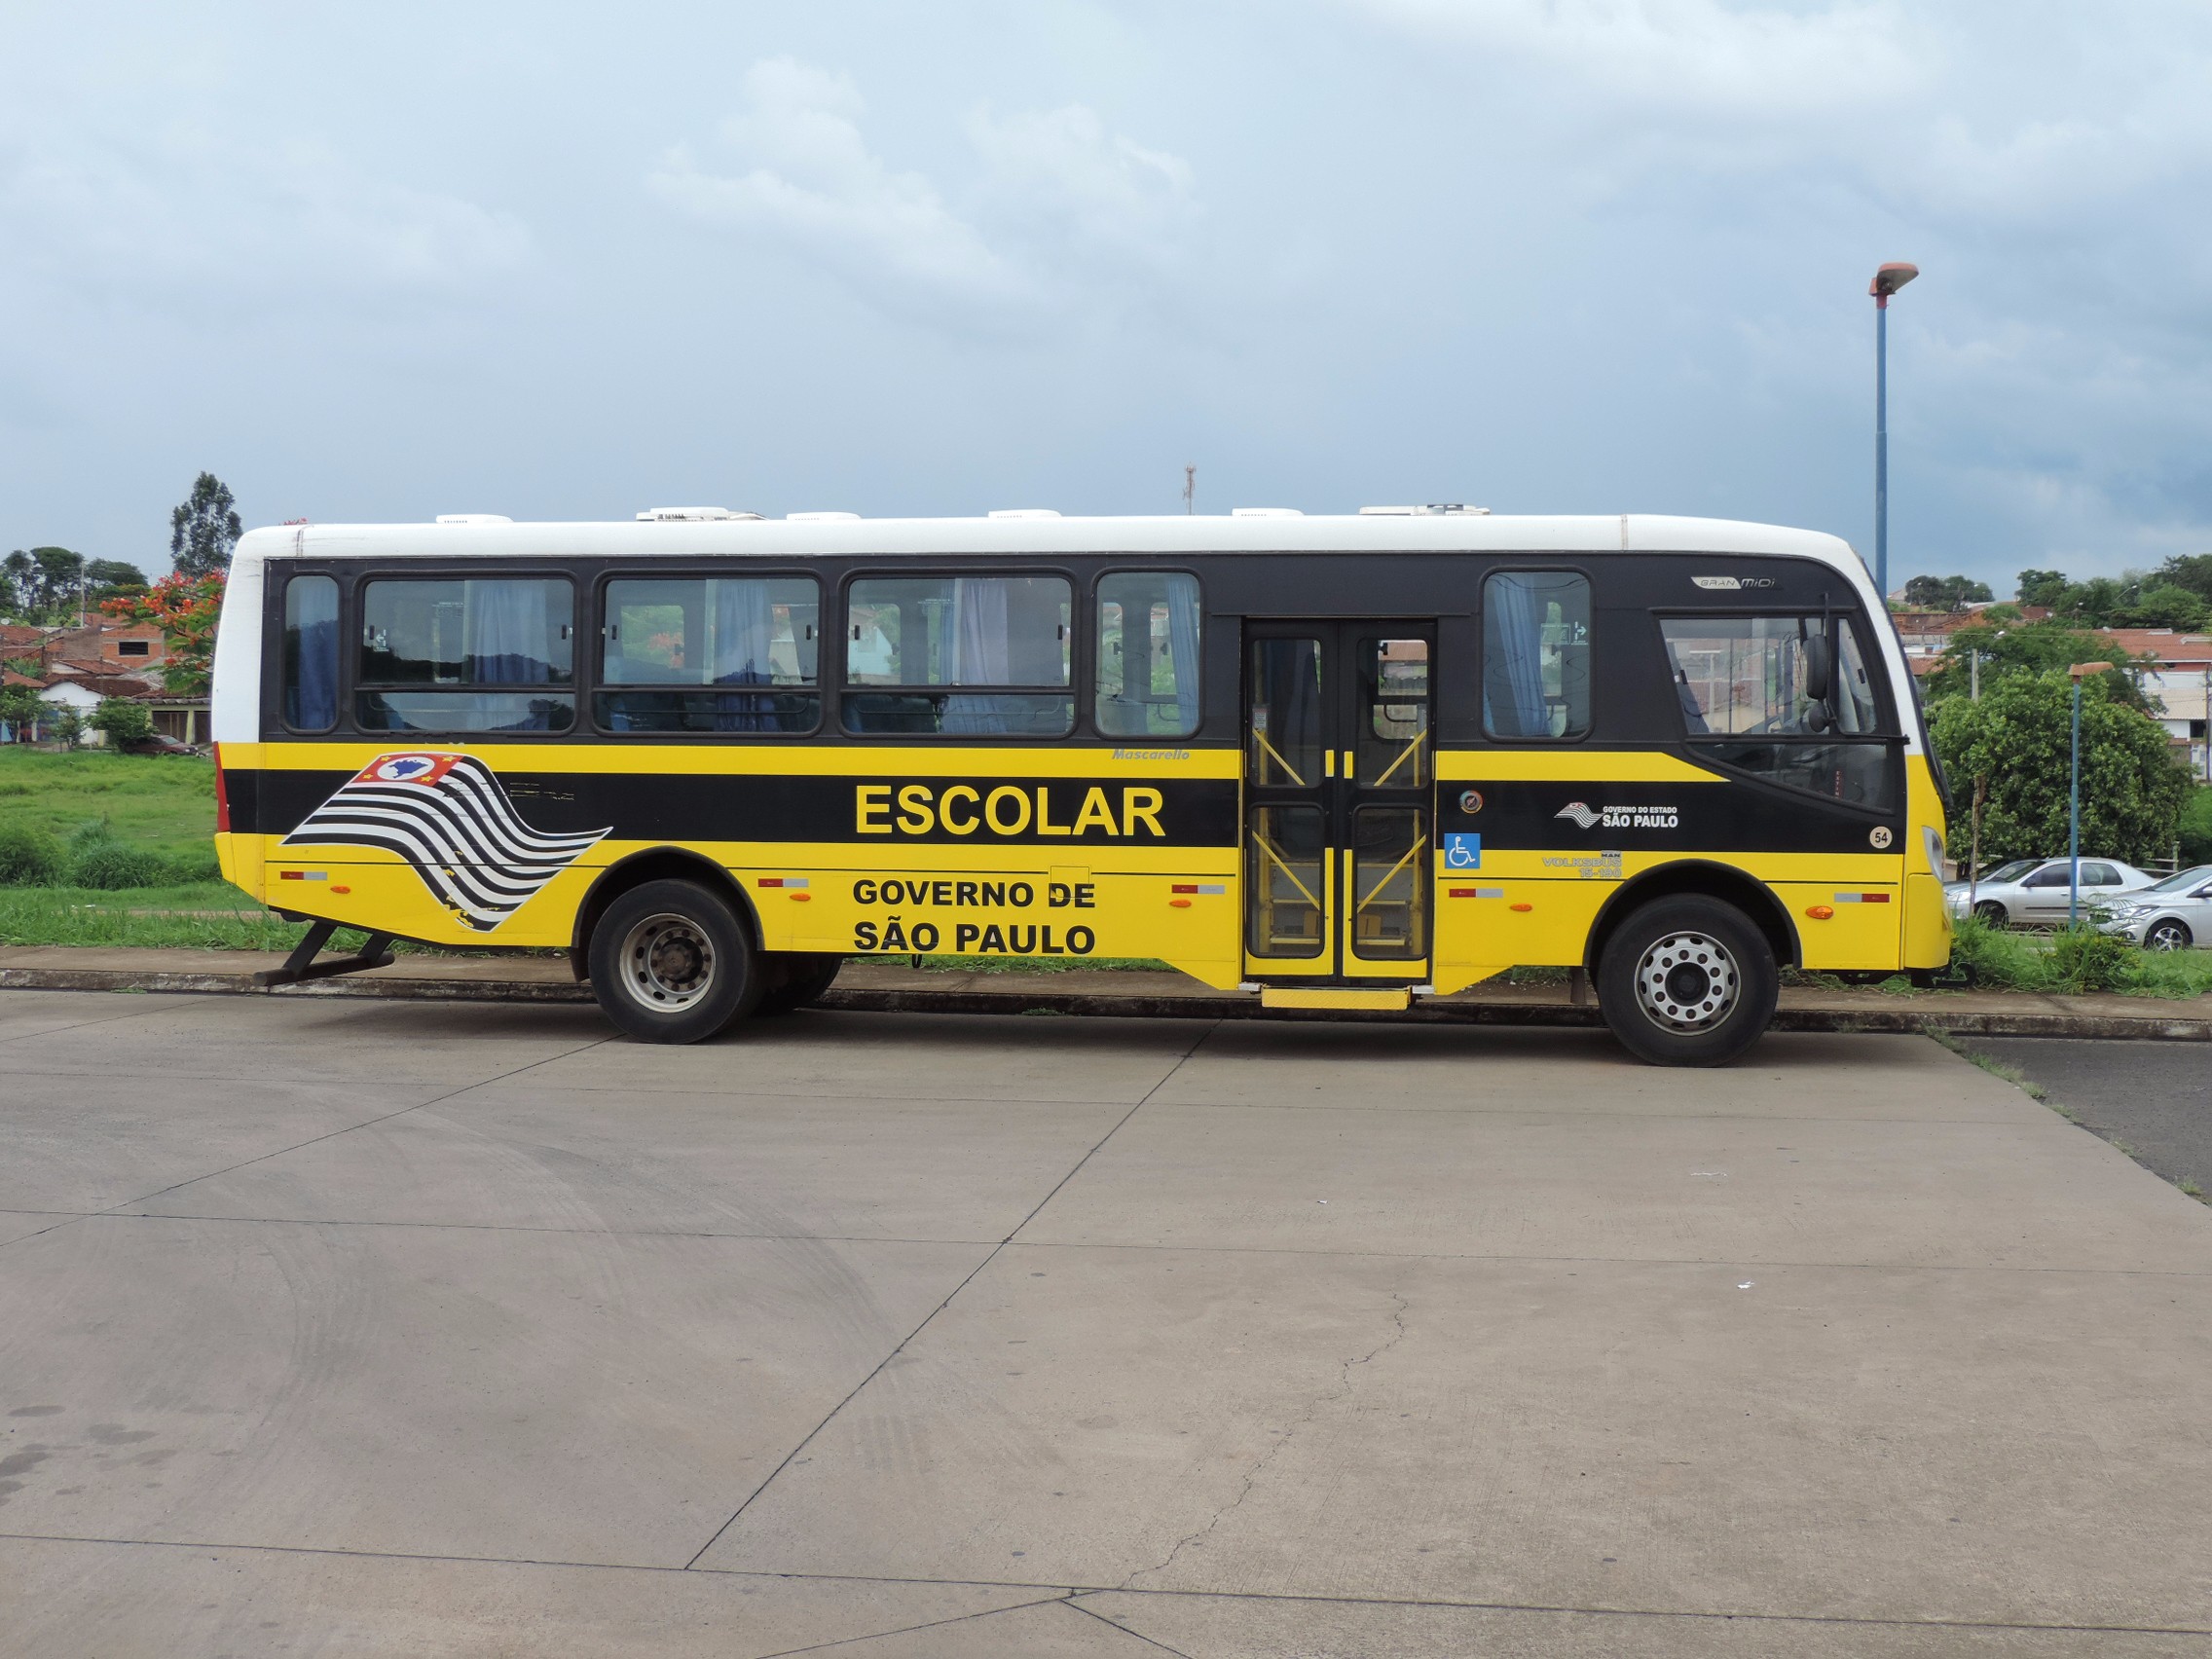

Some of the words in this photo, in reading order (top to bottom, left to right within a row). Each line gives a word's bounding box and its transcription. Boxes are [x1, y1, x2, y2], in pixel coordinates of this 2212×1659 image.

[1112, 748, 1191, 760] Mascarello
[856, 785, 1166, 836] ESCOLAR
[1603, 813, 1631, 828] SÃO
[1634, 815, 1678, 828] PAULO
[1874, 832, 1888, 843] 54
[1542, 857, 1622, 867] VOLKSBUS
[853, 879, 1035, 907] GOVERNO
[1049, 883, 1096, 907] DE
[854, 915, 940, 952] SÃO
[956, 923, 1096, 955] PAULO
